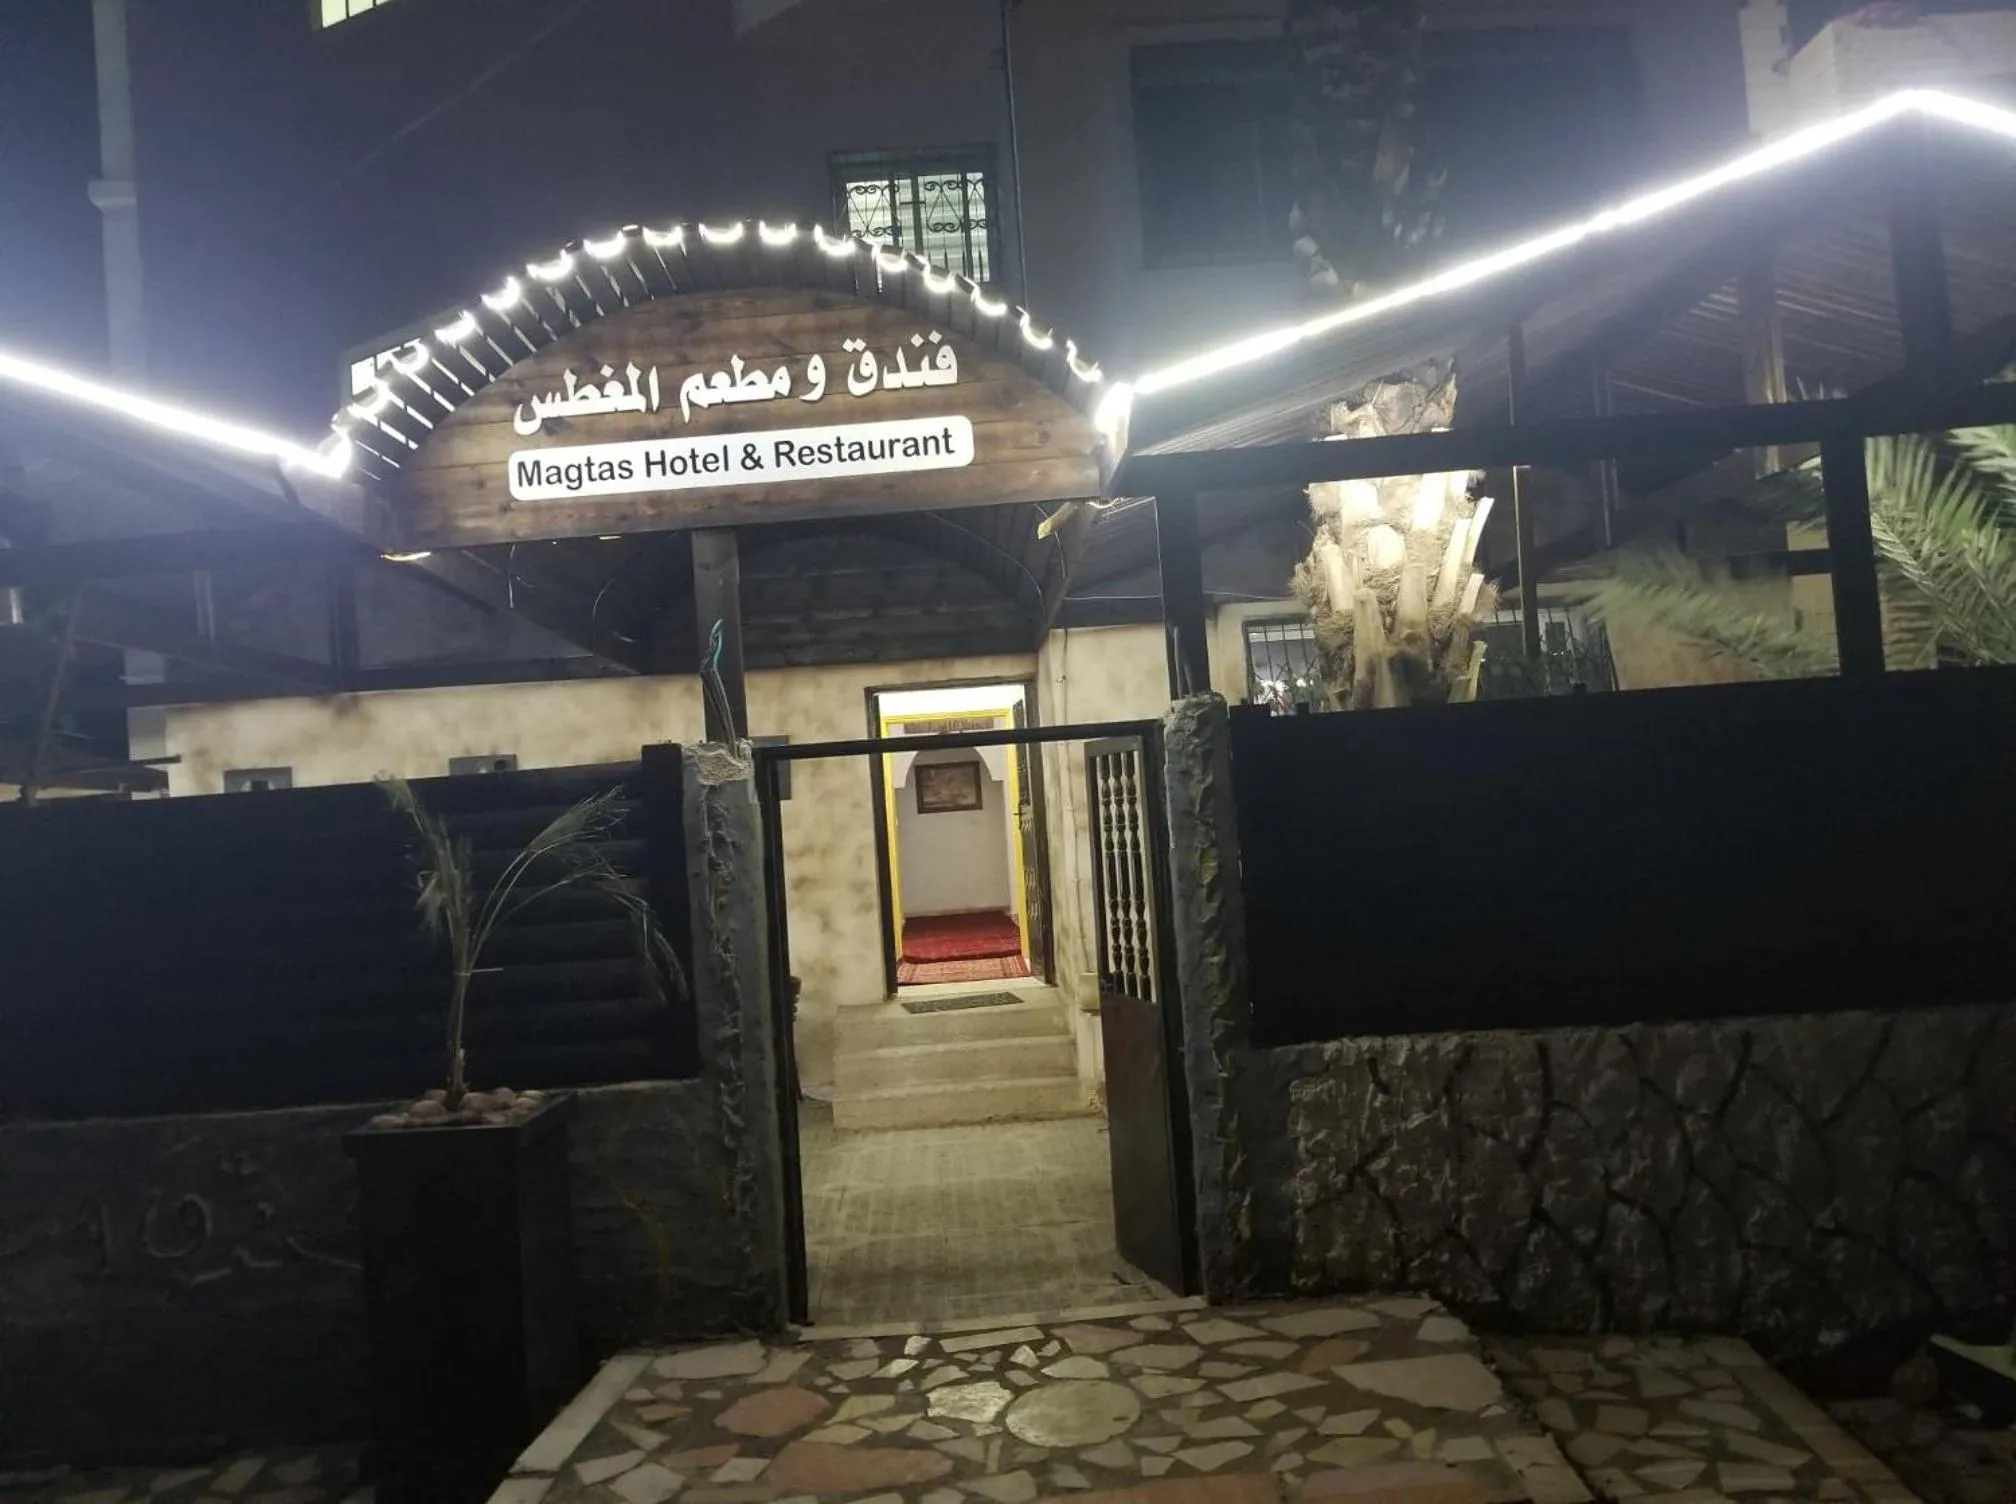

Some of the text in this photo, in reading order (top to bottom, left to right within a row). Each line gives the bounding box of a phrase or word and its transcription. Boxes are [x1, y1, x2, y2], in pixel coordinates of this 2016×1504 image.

[513, 329, 958, 436] فندق و مطعم المغطس
[517, 427, 956, 491] Magtas Hotel & Restaurant
